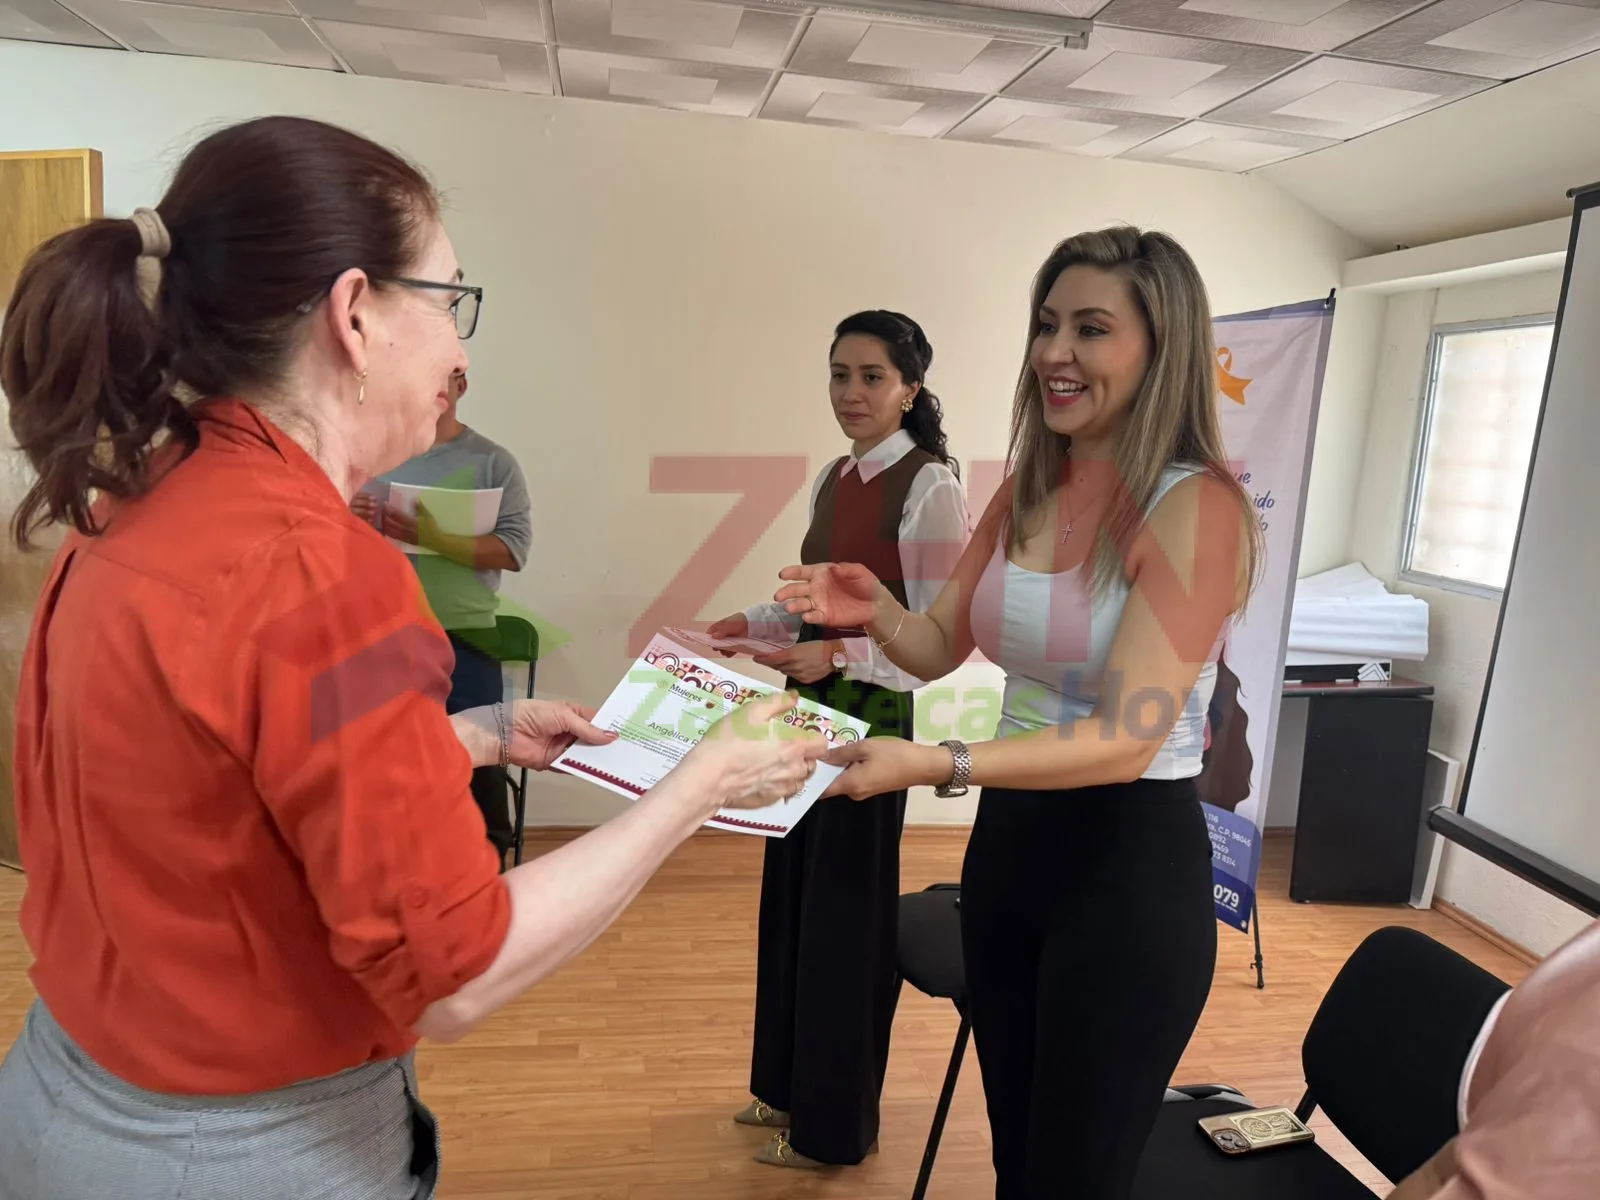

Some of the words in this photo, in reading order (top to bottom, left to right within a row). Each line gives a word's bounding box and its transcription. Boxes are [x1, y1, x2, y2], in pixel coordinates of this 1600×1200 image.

[1234, 472, 1251, 484] ue
[1253, 490, 1275, 510] ido
[670, 684, 702, 702] Mujeres
[1213, 884, 1239, 907] 079
